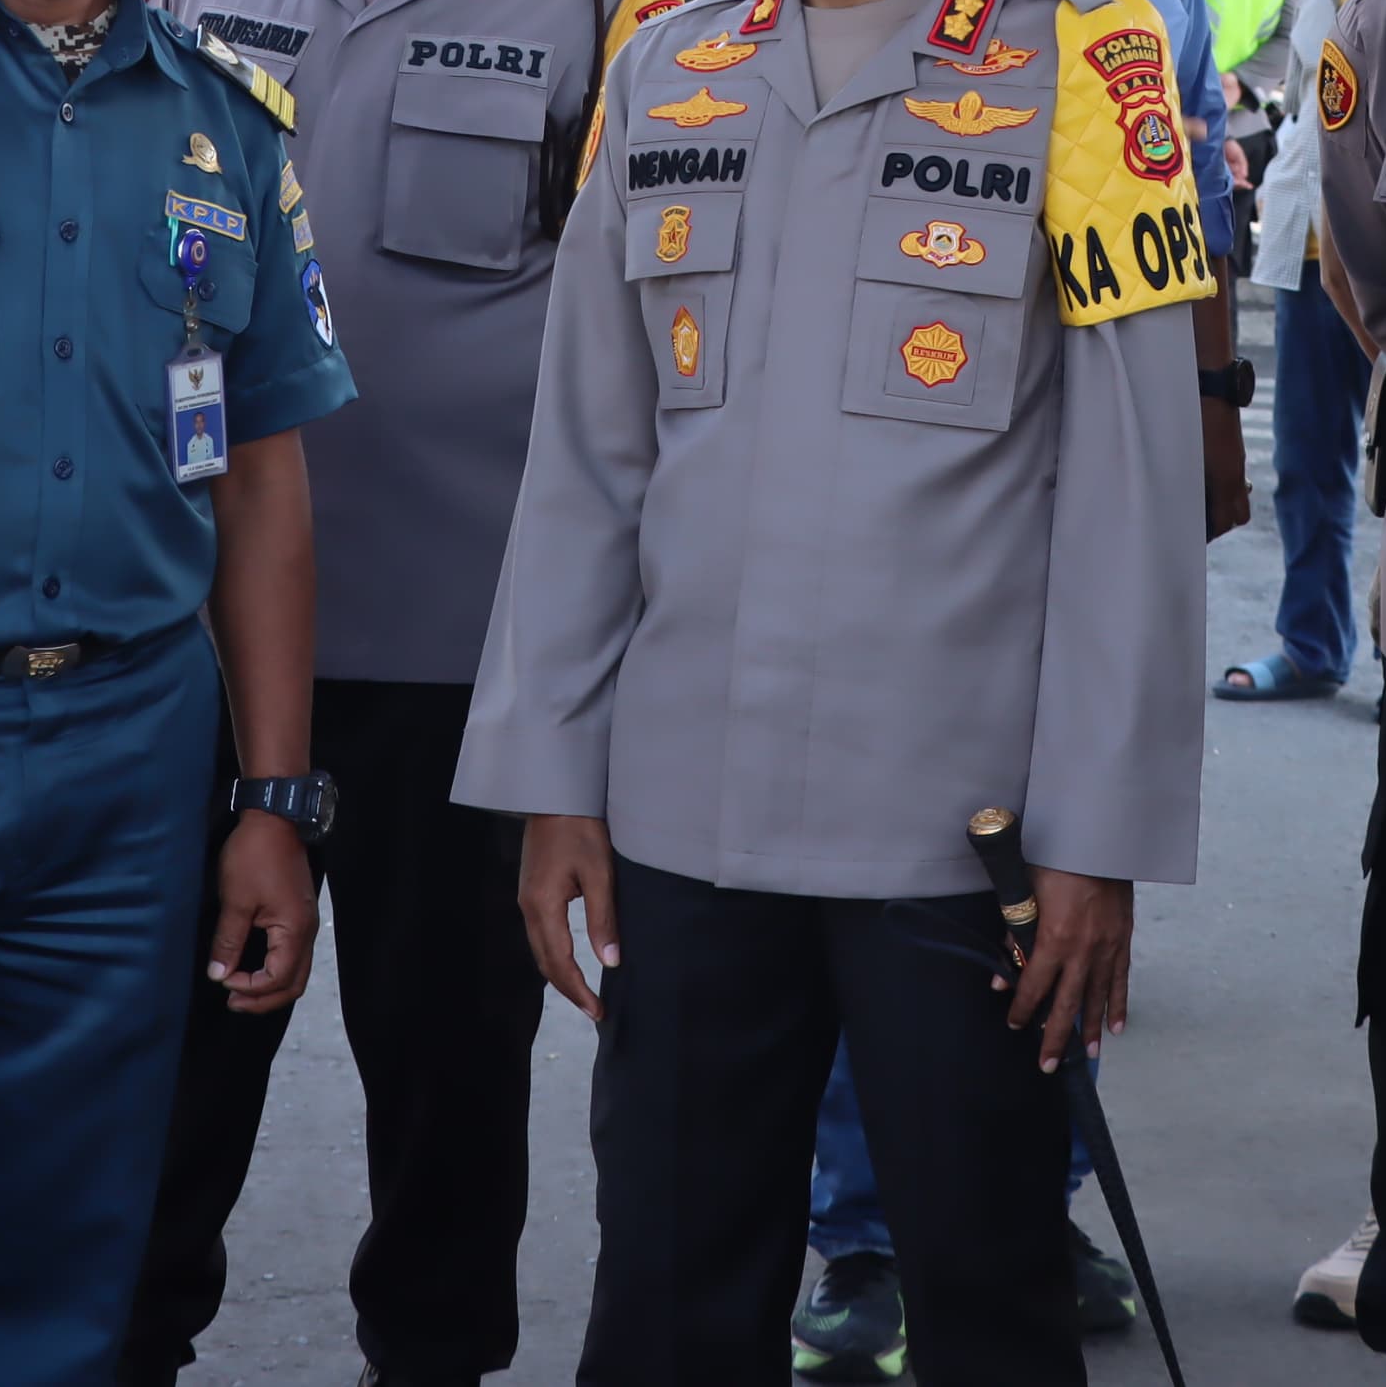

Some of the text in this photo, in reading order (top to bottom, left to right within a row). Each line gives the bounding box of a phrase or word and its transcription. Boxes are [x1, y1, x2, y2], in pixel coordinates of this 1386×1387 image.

[408, 40, 546, 79] POLRI
[1094, 35, 1158, 63] POLRES
[1117, 75, 1161, 95] BALI
[628, 148, 747, 191] NENGAH
[882, 152, 1031, 204] POLRI
[172, 200, 239, 231] KPLP
[1051, 225, 1121, 312] KA
